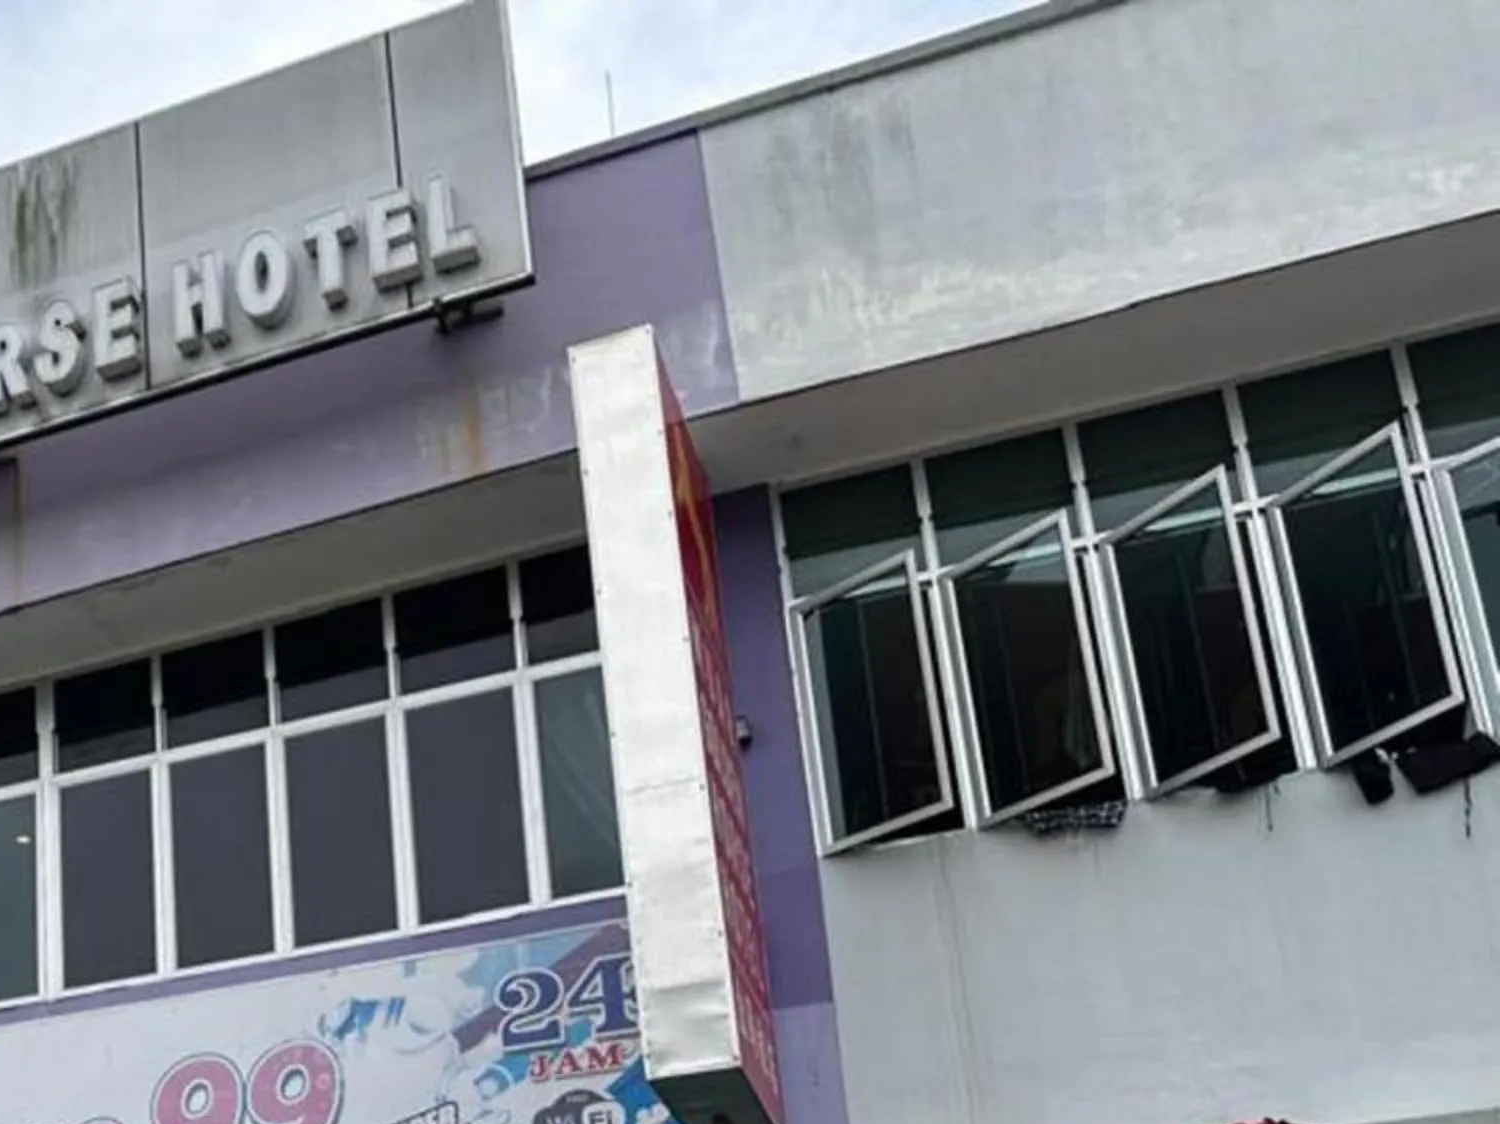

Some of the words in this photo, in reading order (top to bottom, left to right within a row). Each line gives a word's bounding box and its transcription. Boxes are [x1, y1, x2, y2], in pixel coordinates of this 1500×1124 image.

[172, 172, 481, 358] HOTEL
[494, 952, 640, 1051] 24
[529, 1042, 623, 1083] JAM
